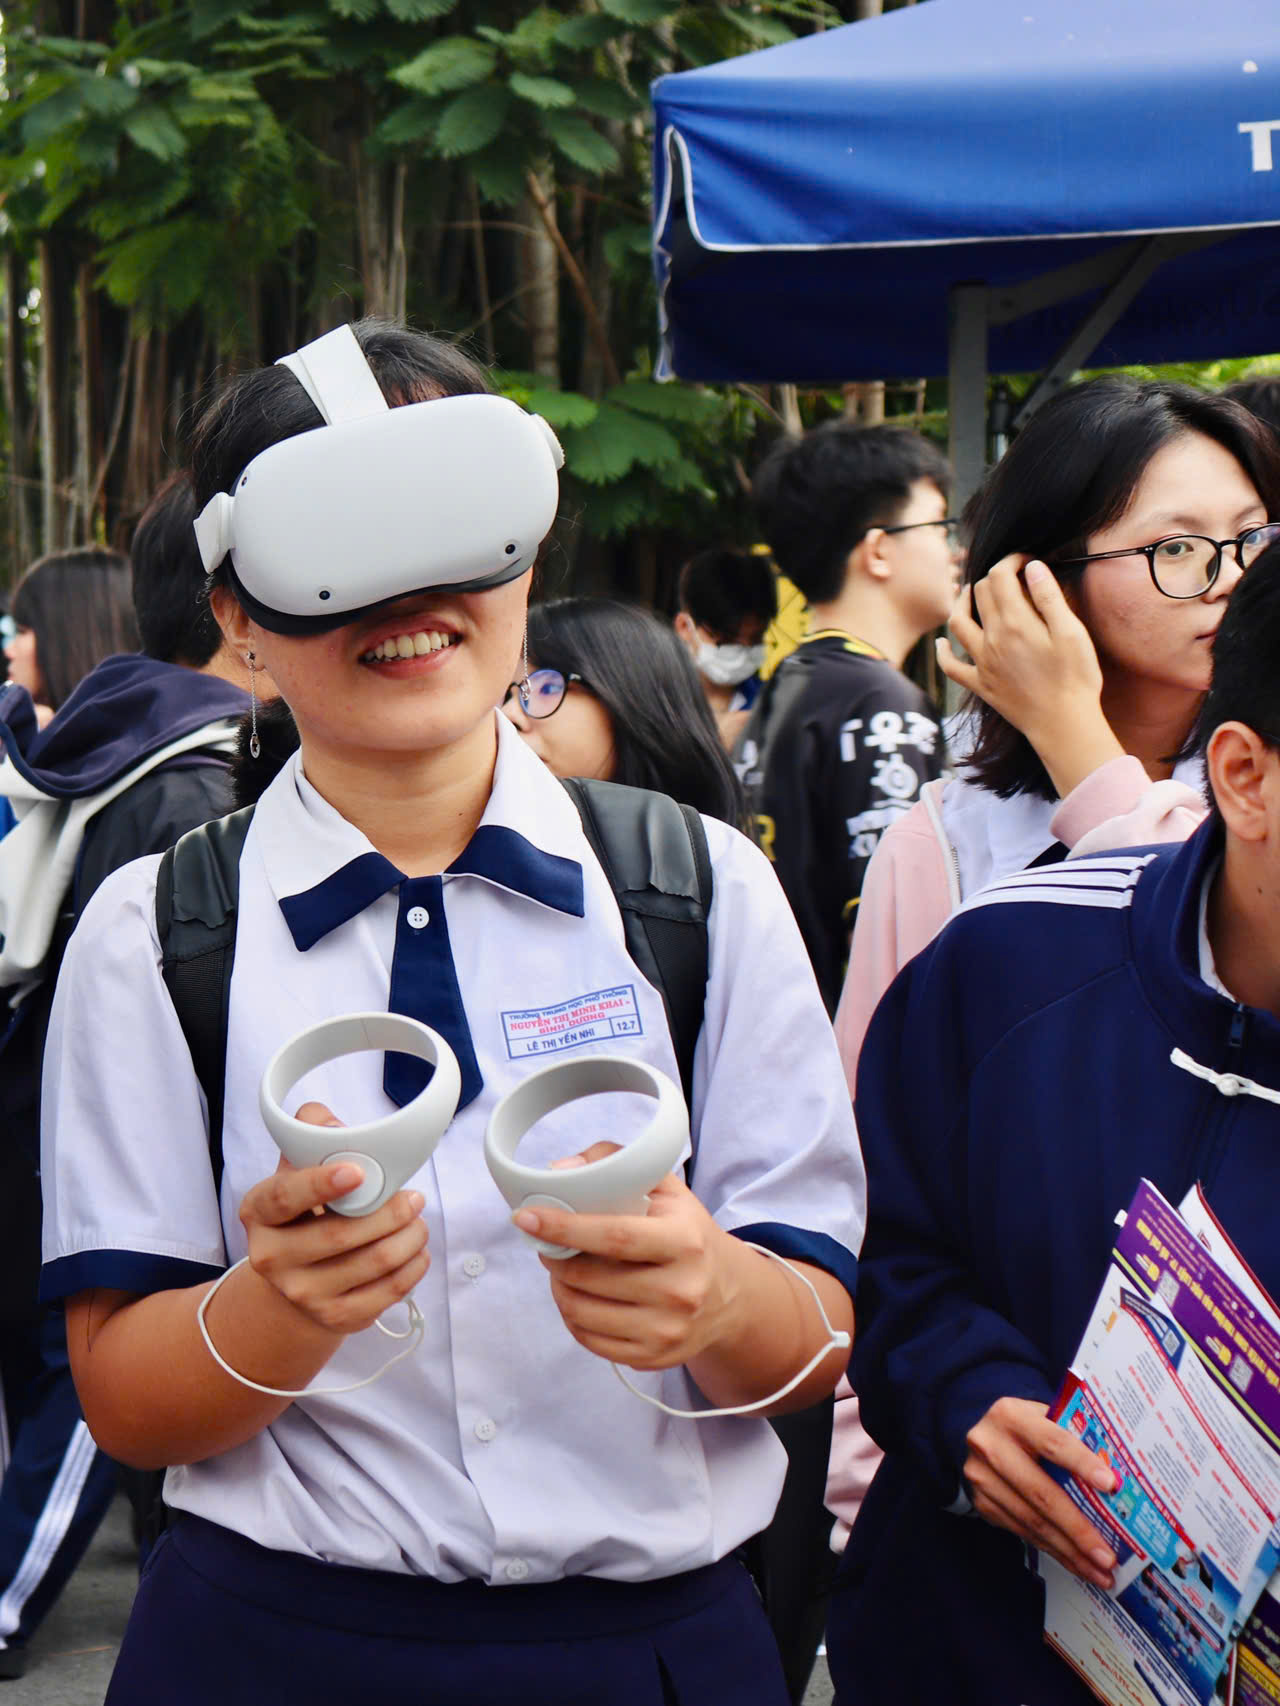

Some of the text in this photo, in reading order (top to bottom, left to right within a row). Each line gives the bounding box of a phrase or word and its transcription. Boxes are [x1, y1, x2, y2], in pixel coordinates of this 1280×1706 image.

[510, 1017, 551, 1031] NGUYỄN
[552, 1013, 570, 1024] THỊ
[571, 1004, 597, 1018] MINH
[598, 999, 624, 1010] KHAI
[542, 1006, 567, 1016] TRUNG
[539, 1012, 605, 1034] BÌNH DƯƠNG
[616, 1020, 636, 1032] 12.7
[527, 1040, 540, 1052] LÊ
[542, 1039, 557, 1050] THỊ
[579, 1028, 596, 1039] NHI
